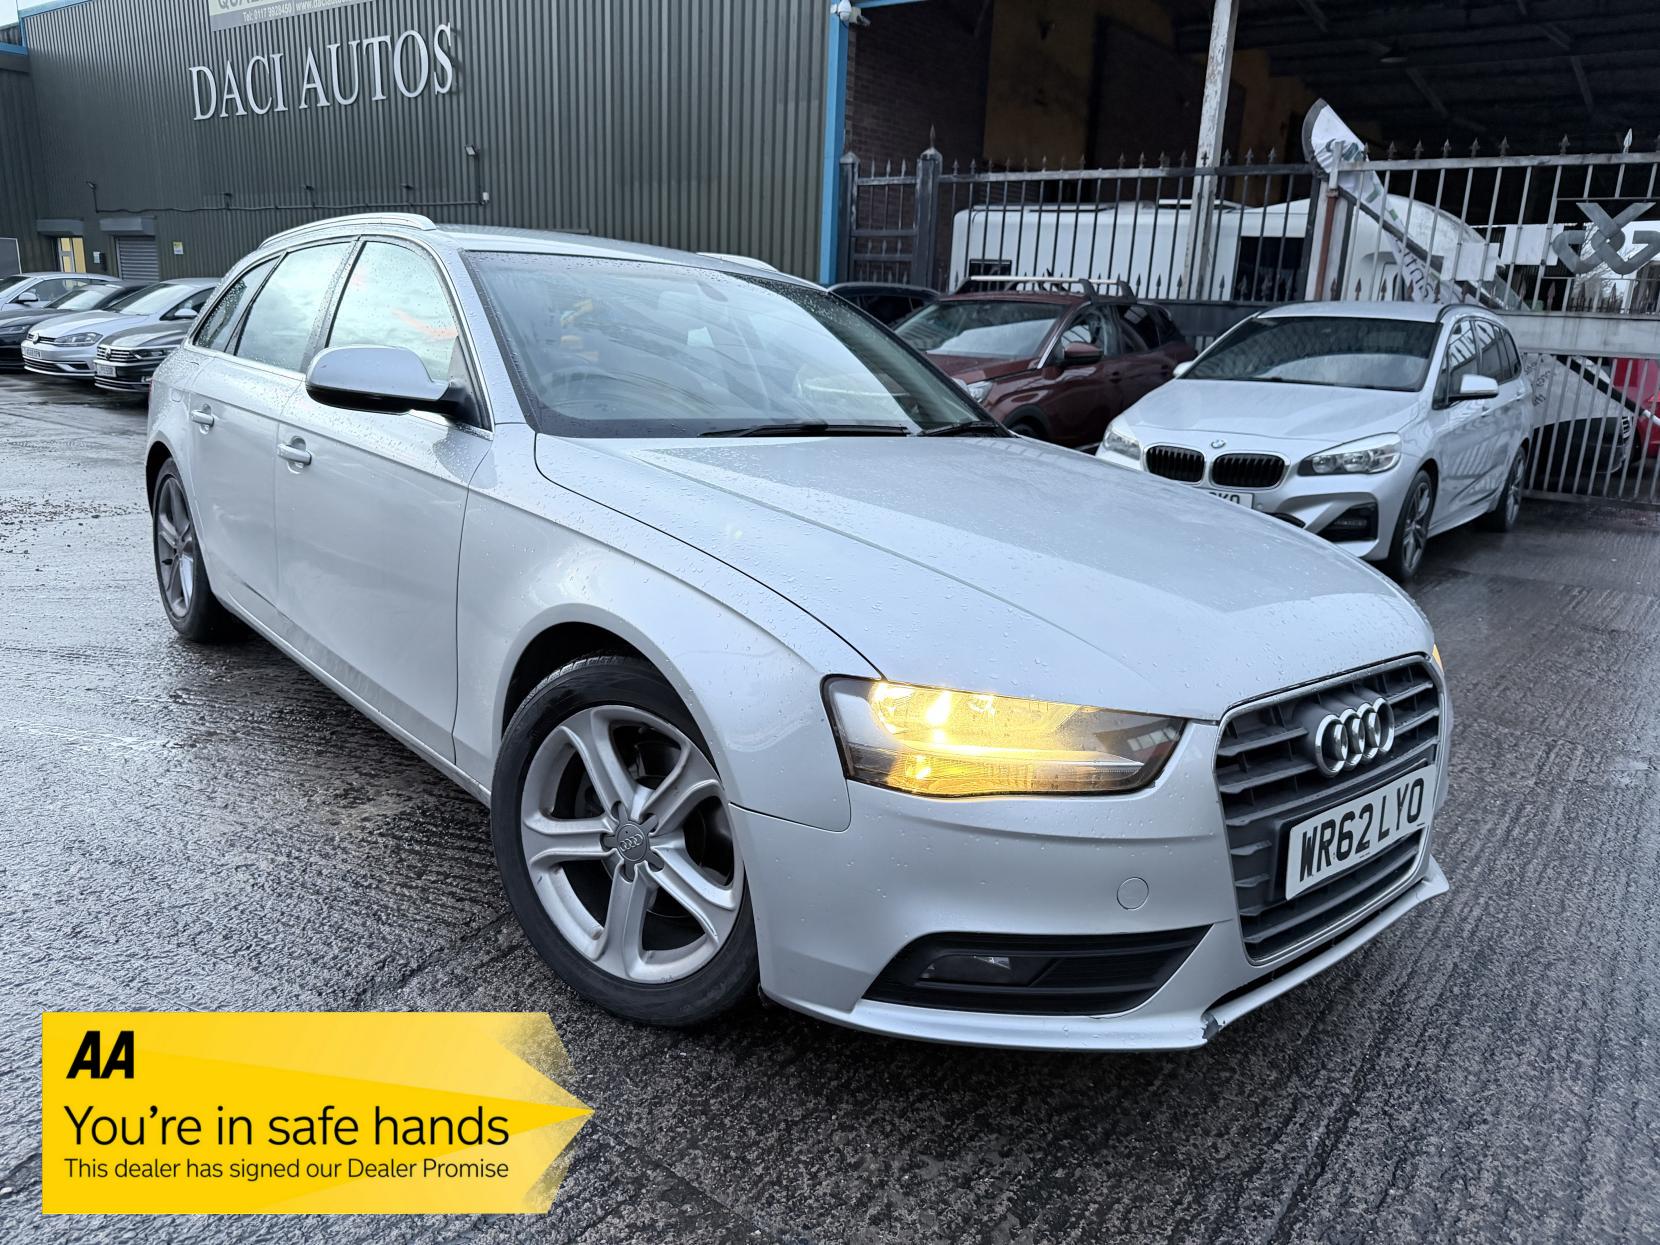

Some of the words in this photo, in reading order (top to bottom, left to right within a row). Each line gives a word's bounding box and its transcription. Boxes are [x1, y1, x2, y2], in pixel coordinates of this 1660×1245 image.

[189, 52, 289, 121] DACI
[299, 22, 453, 109] AUTOS
[1300, 803, 1374, 882] WR62
[1378, 777, 1424, 843] LYO
